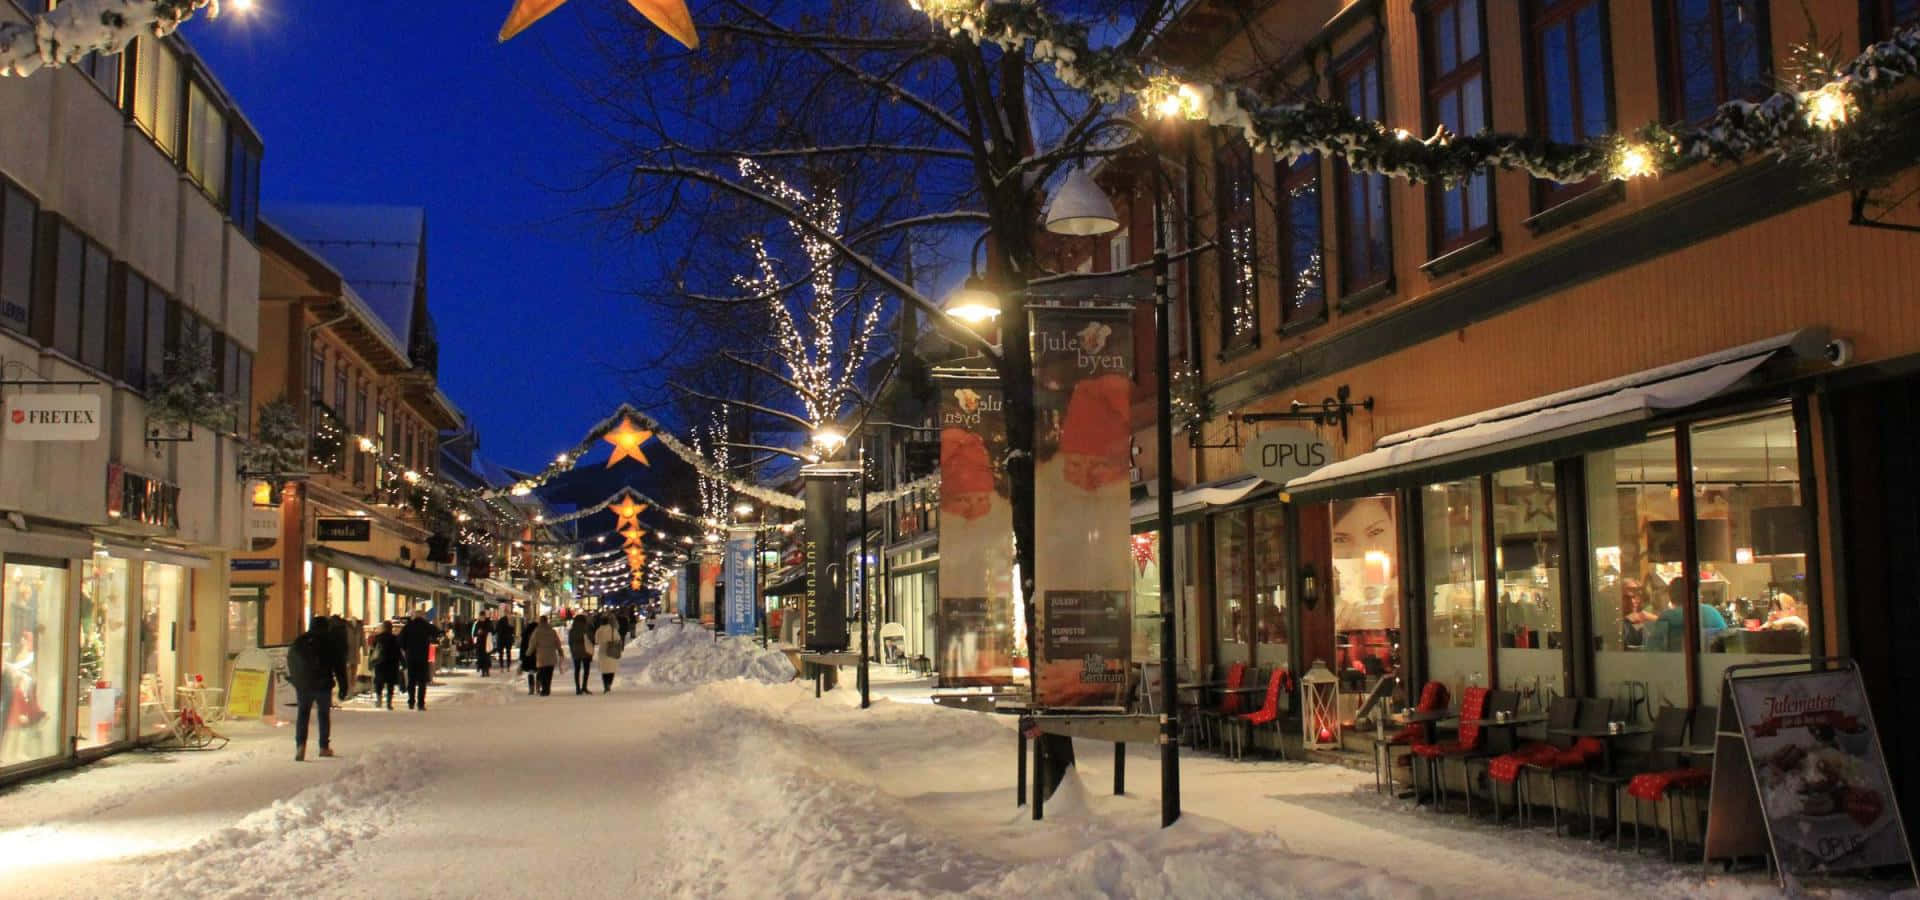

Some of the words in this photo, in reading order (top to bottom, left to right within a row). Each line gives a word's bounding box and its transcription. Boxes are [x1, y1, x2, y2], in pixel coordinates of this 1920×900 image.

[1041, 331, 1078, 352] Jule
[1078, 348, 1125, 374] byen
[29, 410, 95, 425] FRETEX
[1262, 442, 1326, 467] OPUS
[735, 551, 745, 577] CUP
[735, 579, 745, 623] WORLD
[807, 541, 817, 636] KULTURNATT
[1764, 694, 1837, 717] Julematen
